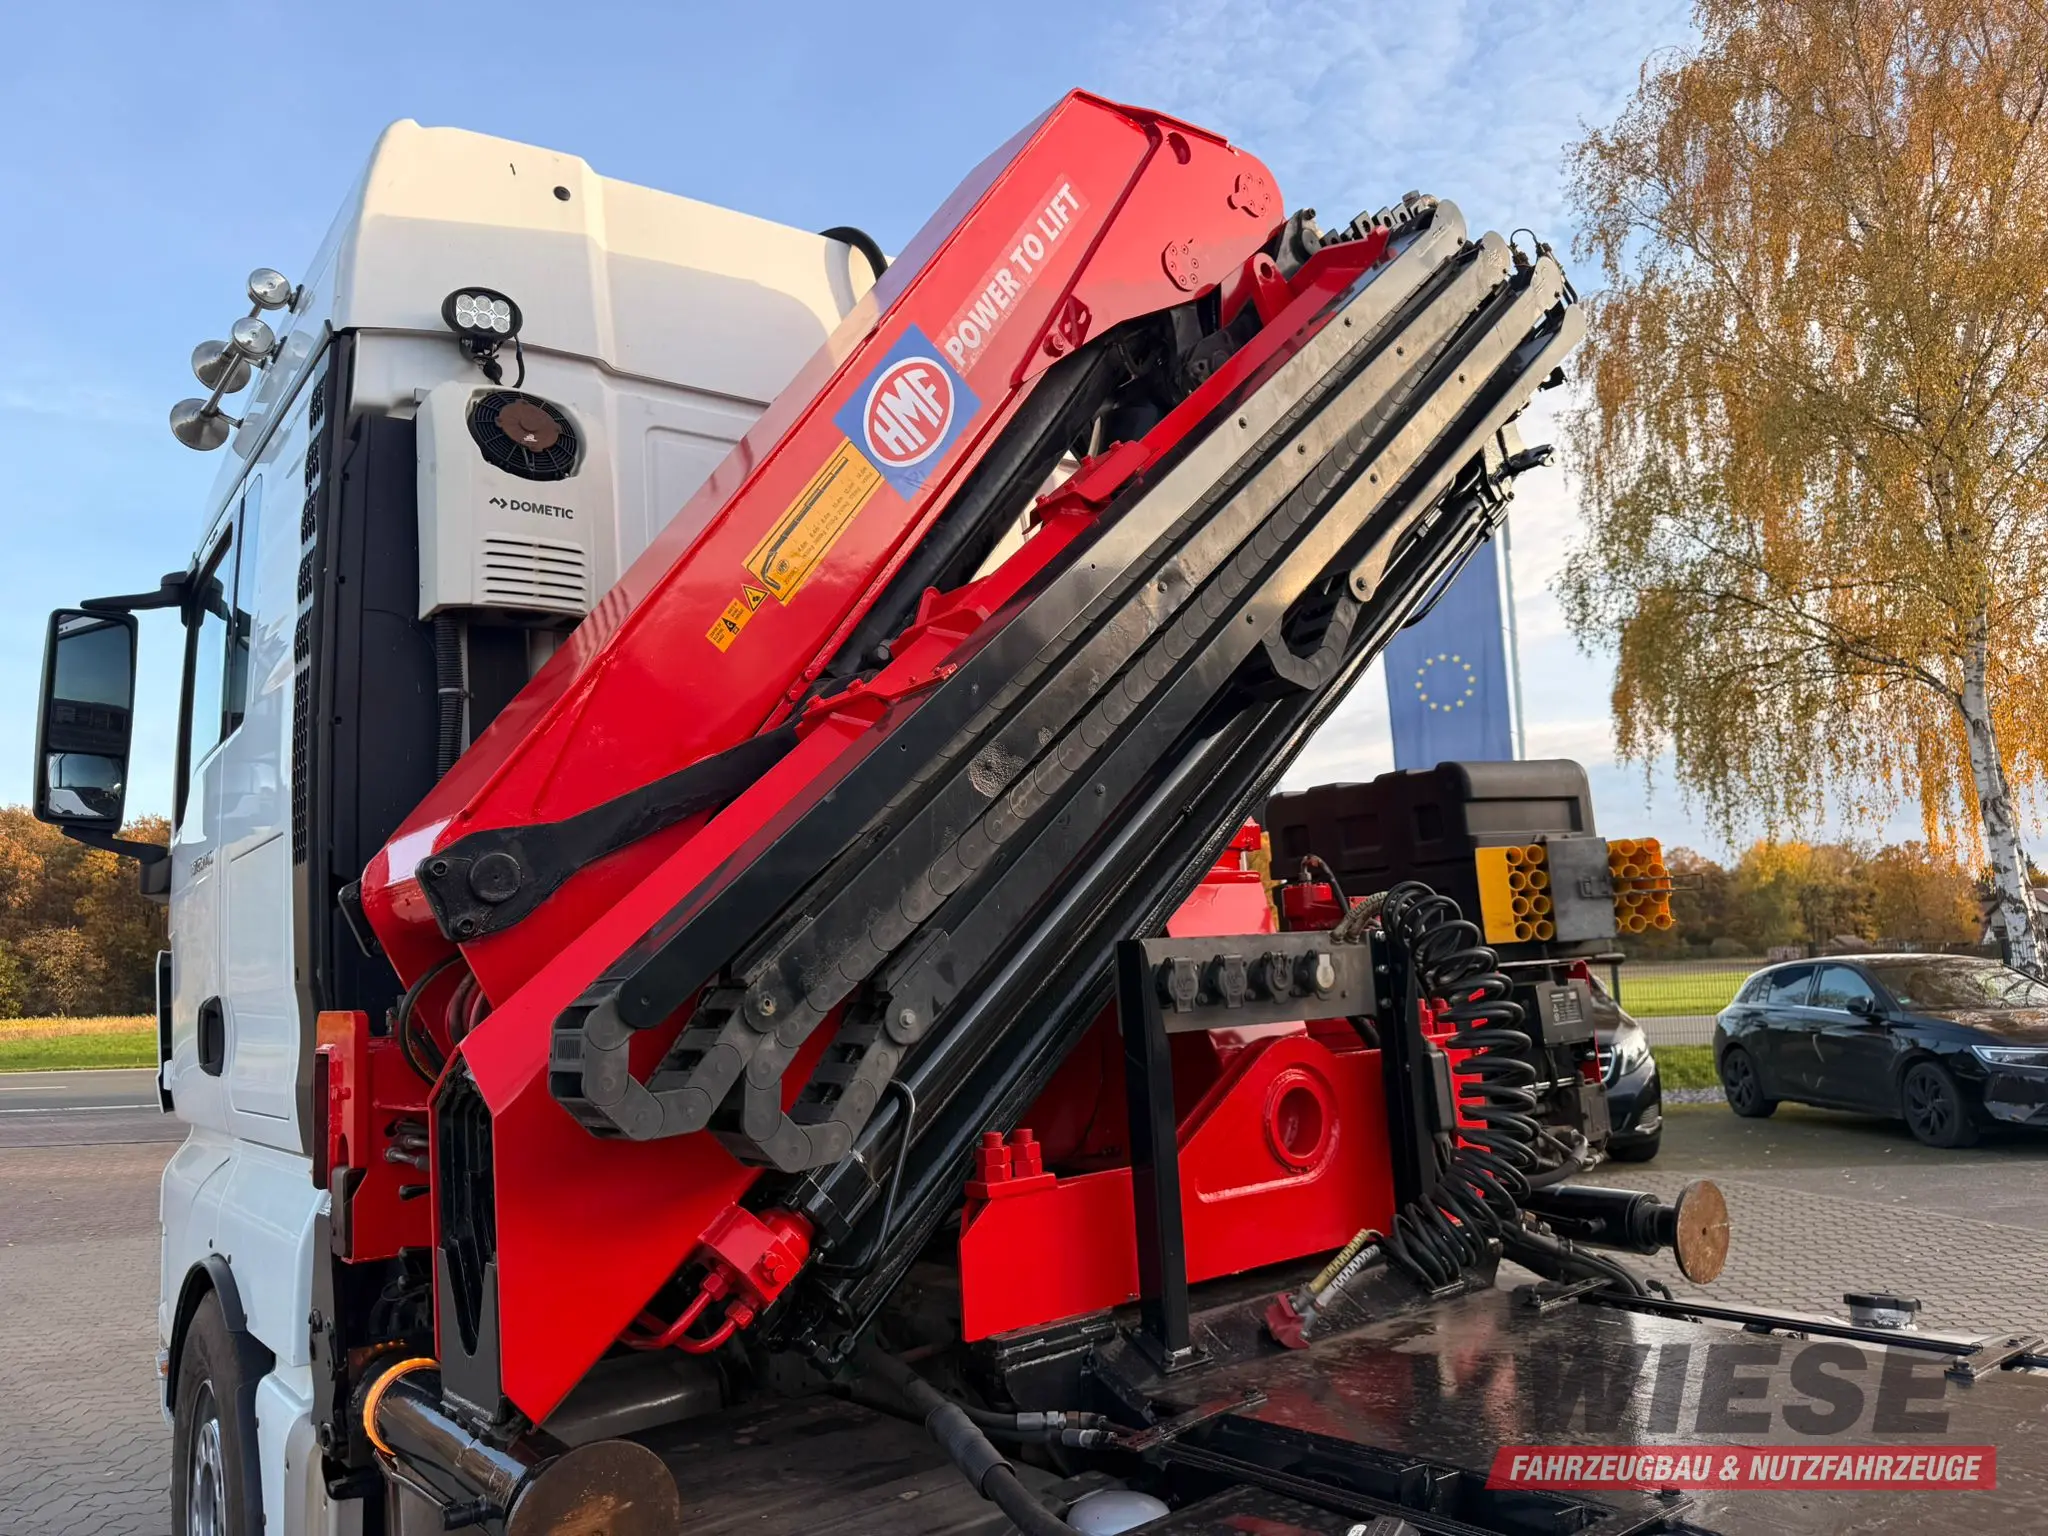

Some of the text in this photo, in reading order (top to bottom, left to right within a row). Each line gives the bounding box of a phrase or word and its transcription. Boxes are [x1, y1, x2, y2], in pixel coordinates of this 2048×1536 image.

[944, 182, 1080, 367] POWER TO LIFT
[873, 368, 944, 456] HMF
[510, 499, 574, 519] DOMETIC
